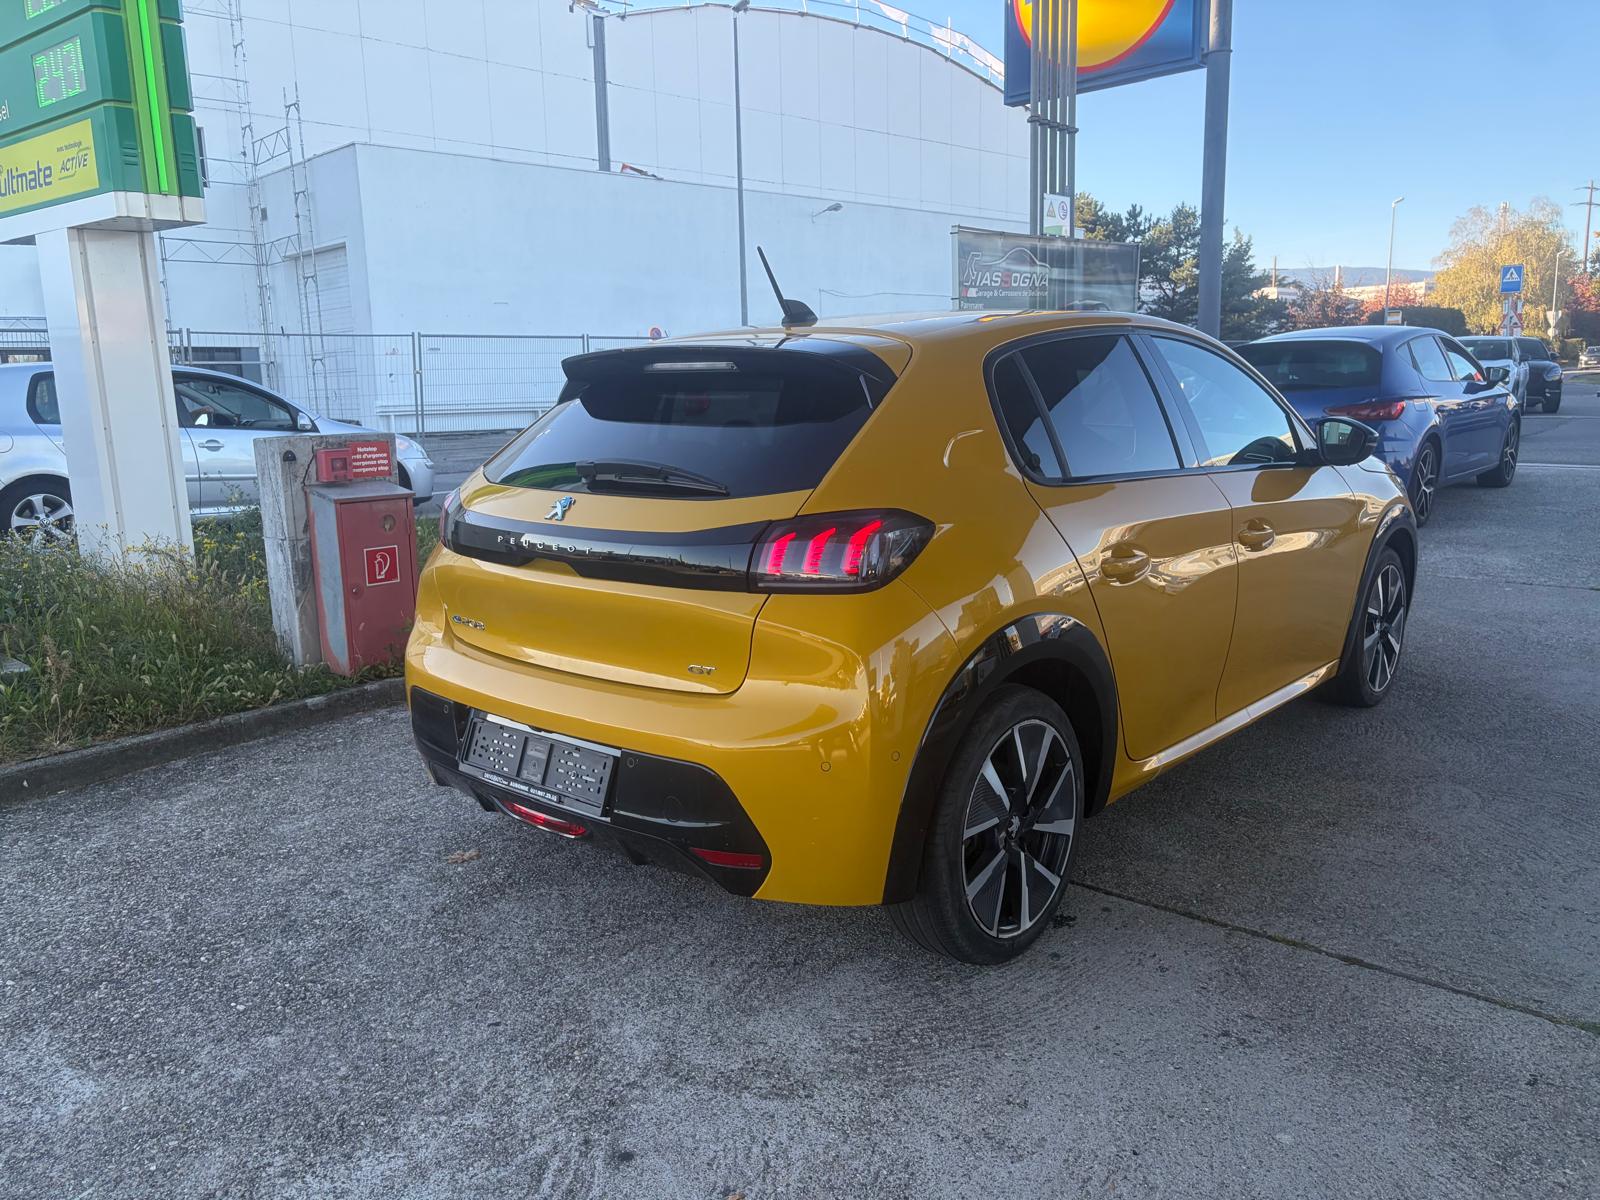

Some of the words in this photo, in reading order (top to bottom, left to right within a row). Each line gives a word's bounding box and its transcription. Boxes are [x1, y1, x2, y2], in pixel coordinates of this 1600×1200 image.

[60, 153, 88, 173] ACTIVE
[497, 535, 592, 555] PEUGEOT
[688, 664, 718, 675] GT
